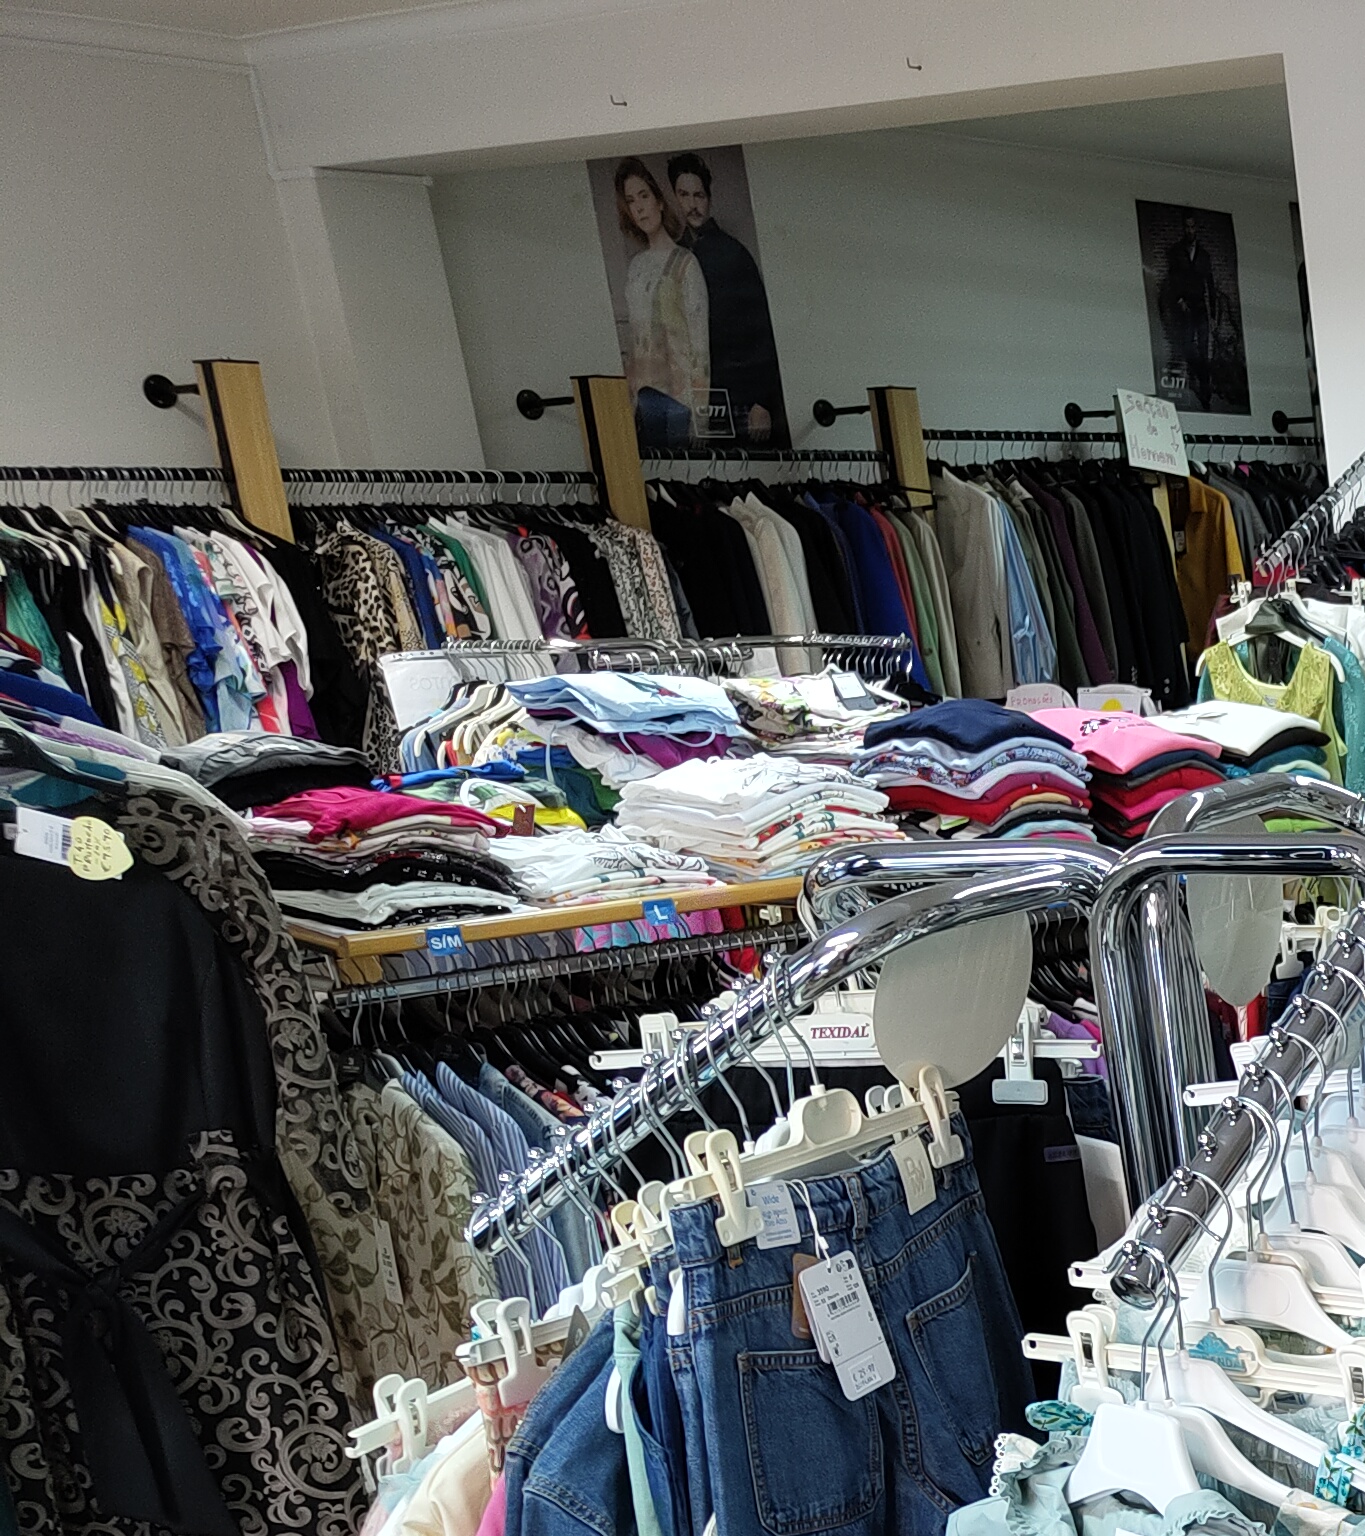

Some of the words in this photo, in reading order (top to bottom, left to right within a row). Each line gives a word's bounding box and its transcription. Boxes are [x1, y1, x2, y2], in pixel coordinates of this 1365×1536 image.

[653, 905, 670, 921] L
[430, 934, 463, 951] S/M
[810, 1024, 869, 1040] TEXIDAL
